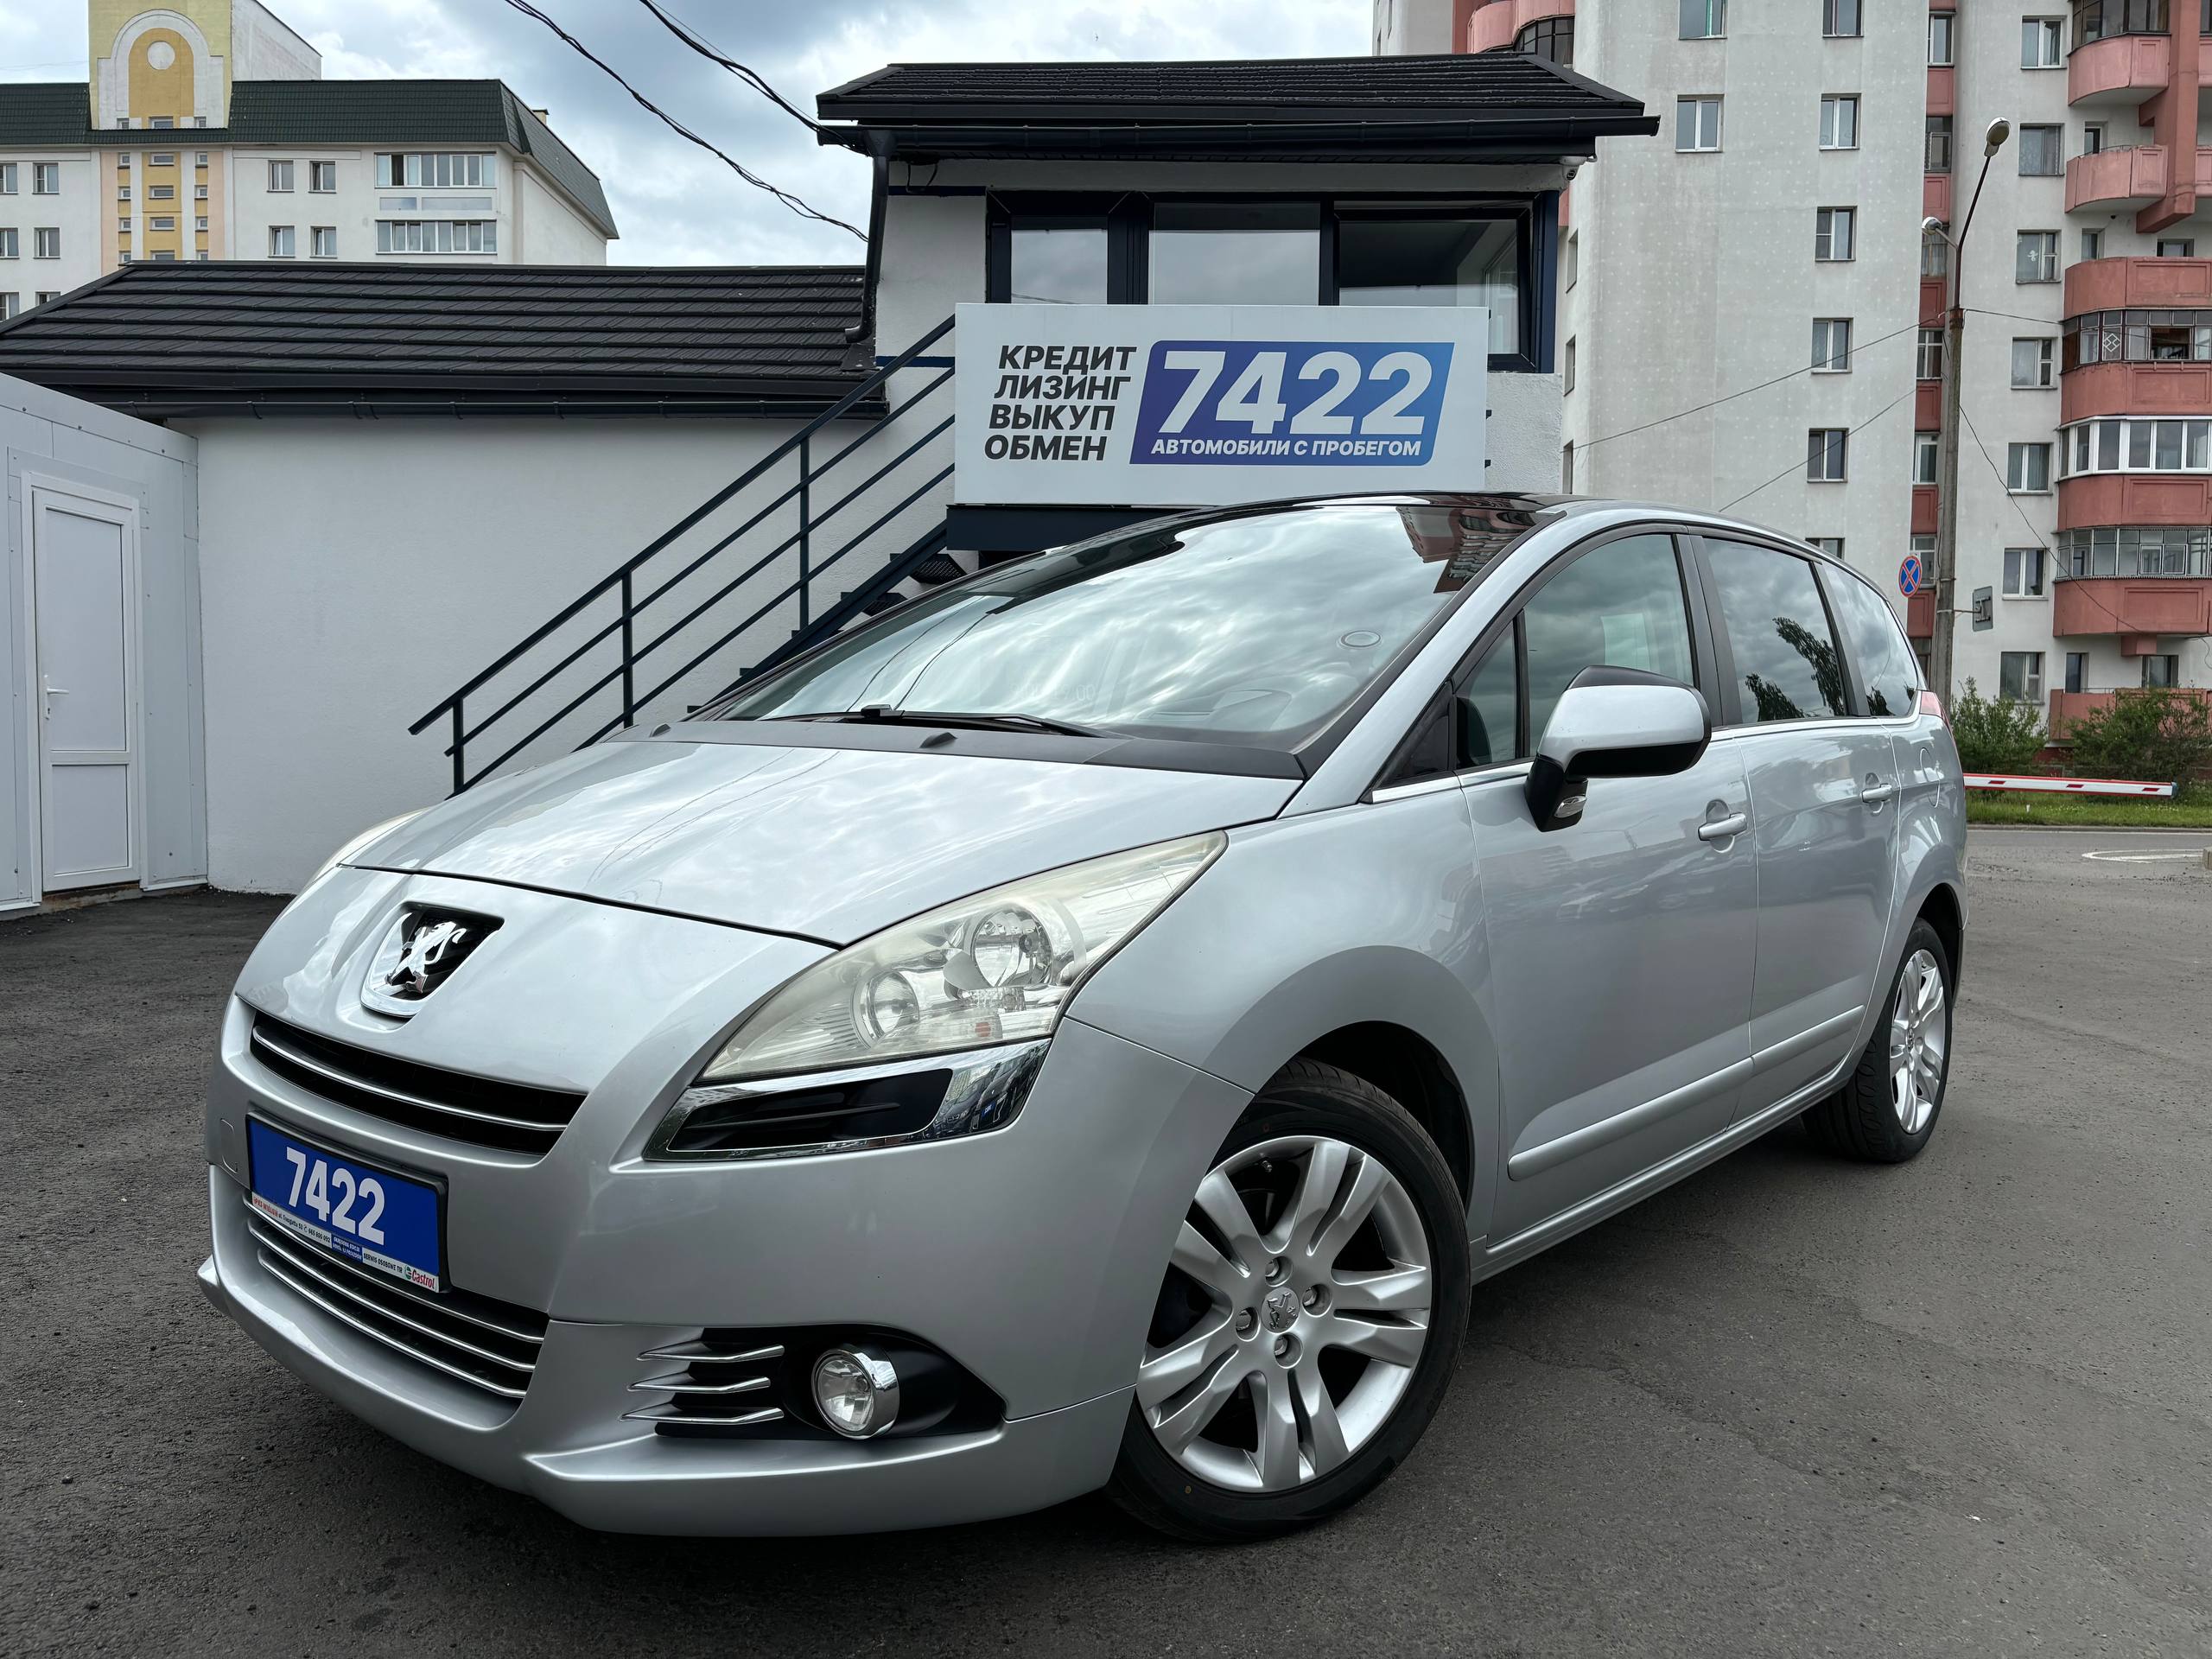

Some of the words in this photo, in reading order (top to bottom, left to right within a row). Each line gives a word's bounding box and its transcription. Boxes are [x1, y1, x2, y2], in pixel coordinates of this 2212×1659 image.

[998, 345, 1138, 376] КРЕДИТ
[994, 374, 1132, 401] ЛИЗИНГ
[1158, 350, 1433, 435] 7422
[988, 404, 1116, 431] ВЫКУП
[984, 434, 1108, 461] ОБМЕН
[1150, 439, 1291, 455] АВТОМОБИЛИ
[1294, 440, 1308, 455] С
[1311, 440, 1422, 456] ПРОБЕГОМ
[286, 1146, 385, 1246] 7422
[411, 1268, 435, 1289] Castrol
